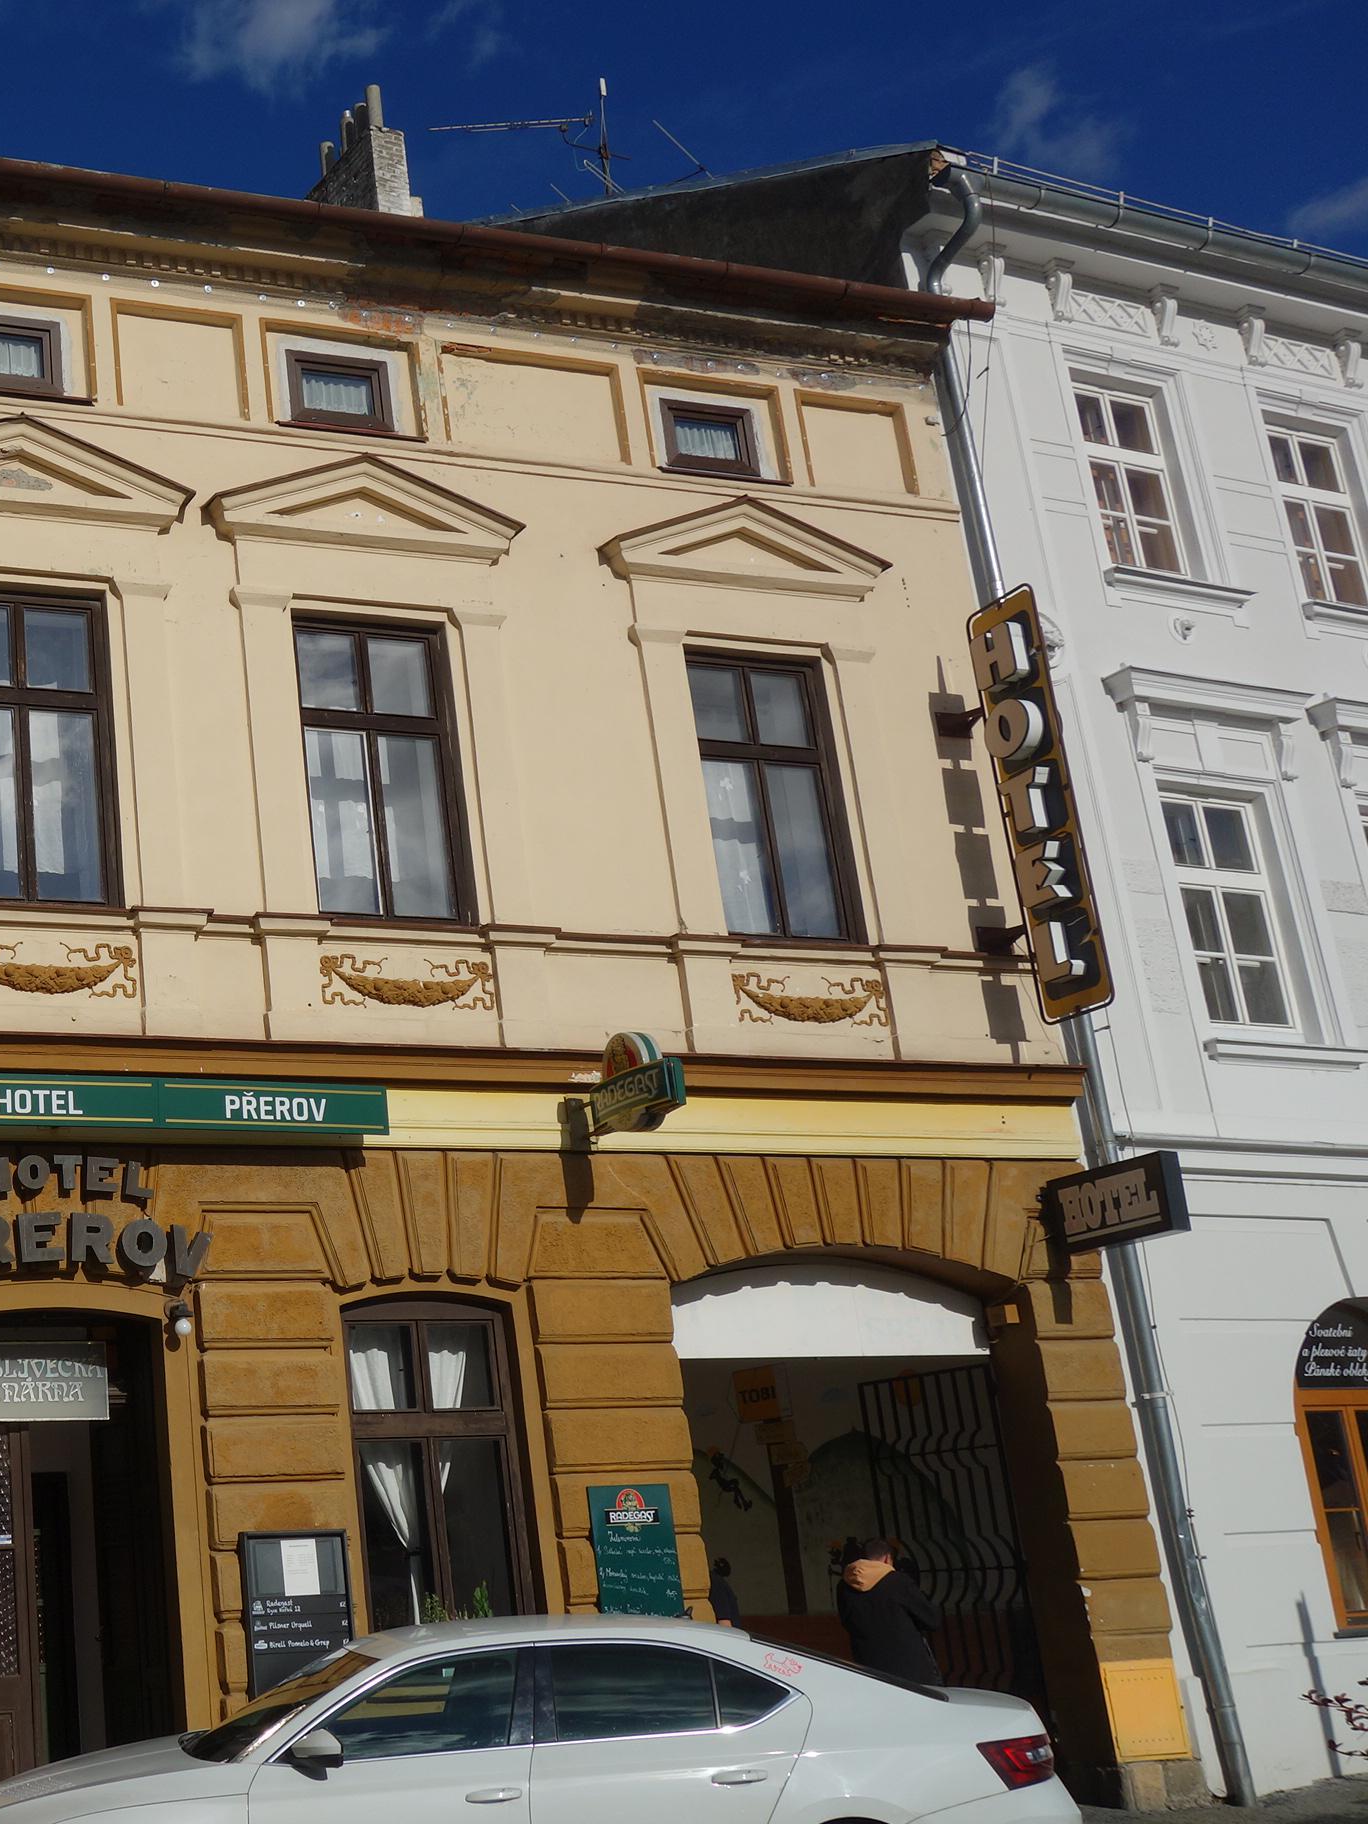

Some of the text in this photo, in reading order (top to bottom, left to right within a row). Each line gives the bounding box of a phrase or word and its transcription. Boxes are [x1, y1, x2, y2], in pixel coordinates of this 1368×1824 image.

[969, 621, 1087, 983] HOTEL
[225, 1091, 326, 1122] PŘEROV
[1057, 1167, 1161, 1235] HOTEL
[1301, 1348, 1309, 1356] a
[609, 1510, 655, 1523] RADEGAST
